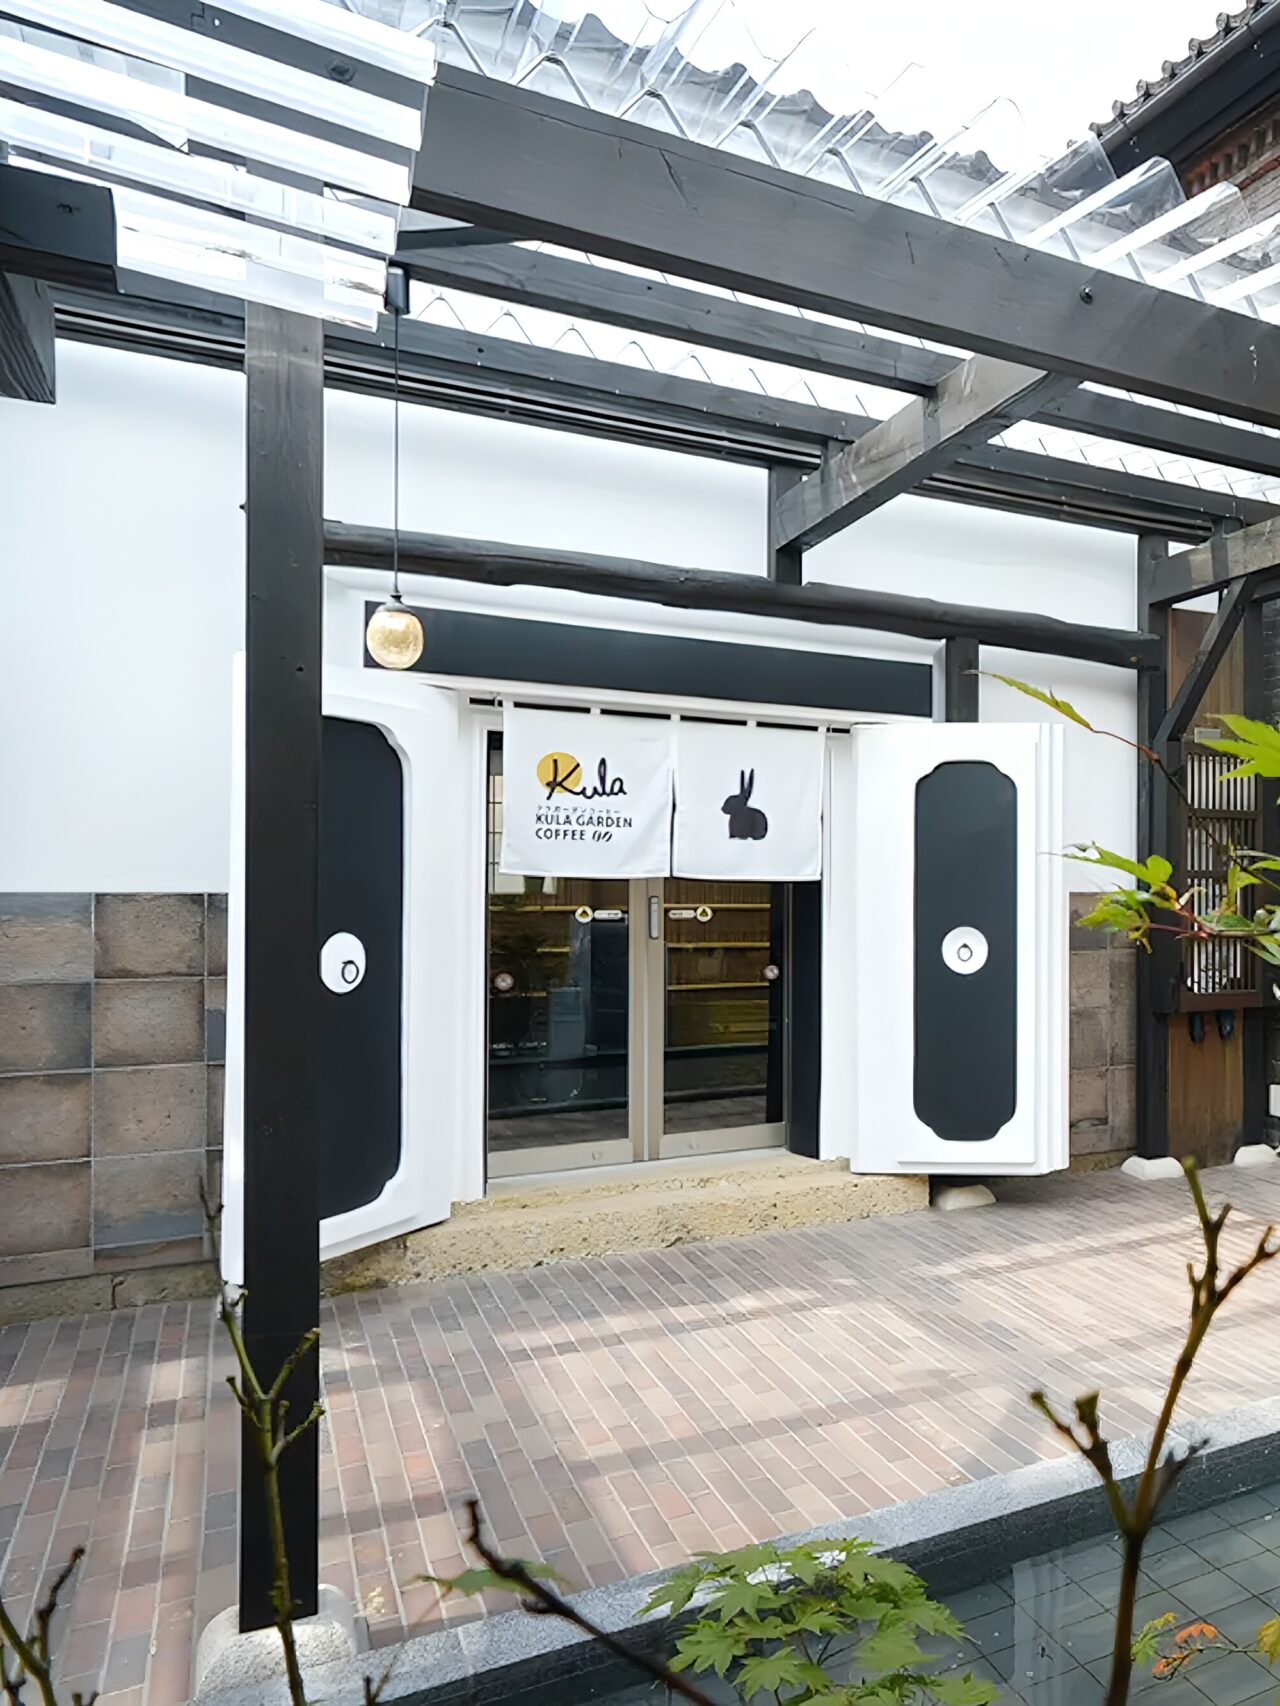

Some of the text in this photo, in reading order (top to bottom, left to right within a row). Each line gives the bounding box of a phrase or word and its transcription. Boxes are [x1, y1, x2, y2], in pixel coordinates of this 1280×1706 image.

[545, 757, 627, 800] Kula
[535, 813, 633, 828] KULA GARDEN
[535, 827, 586, 841] COFFEE
